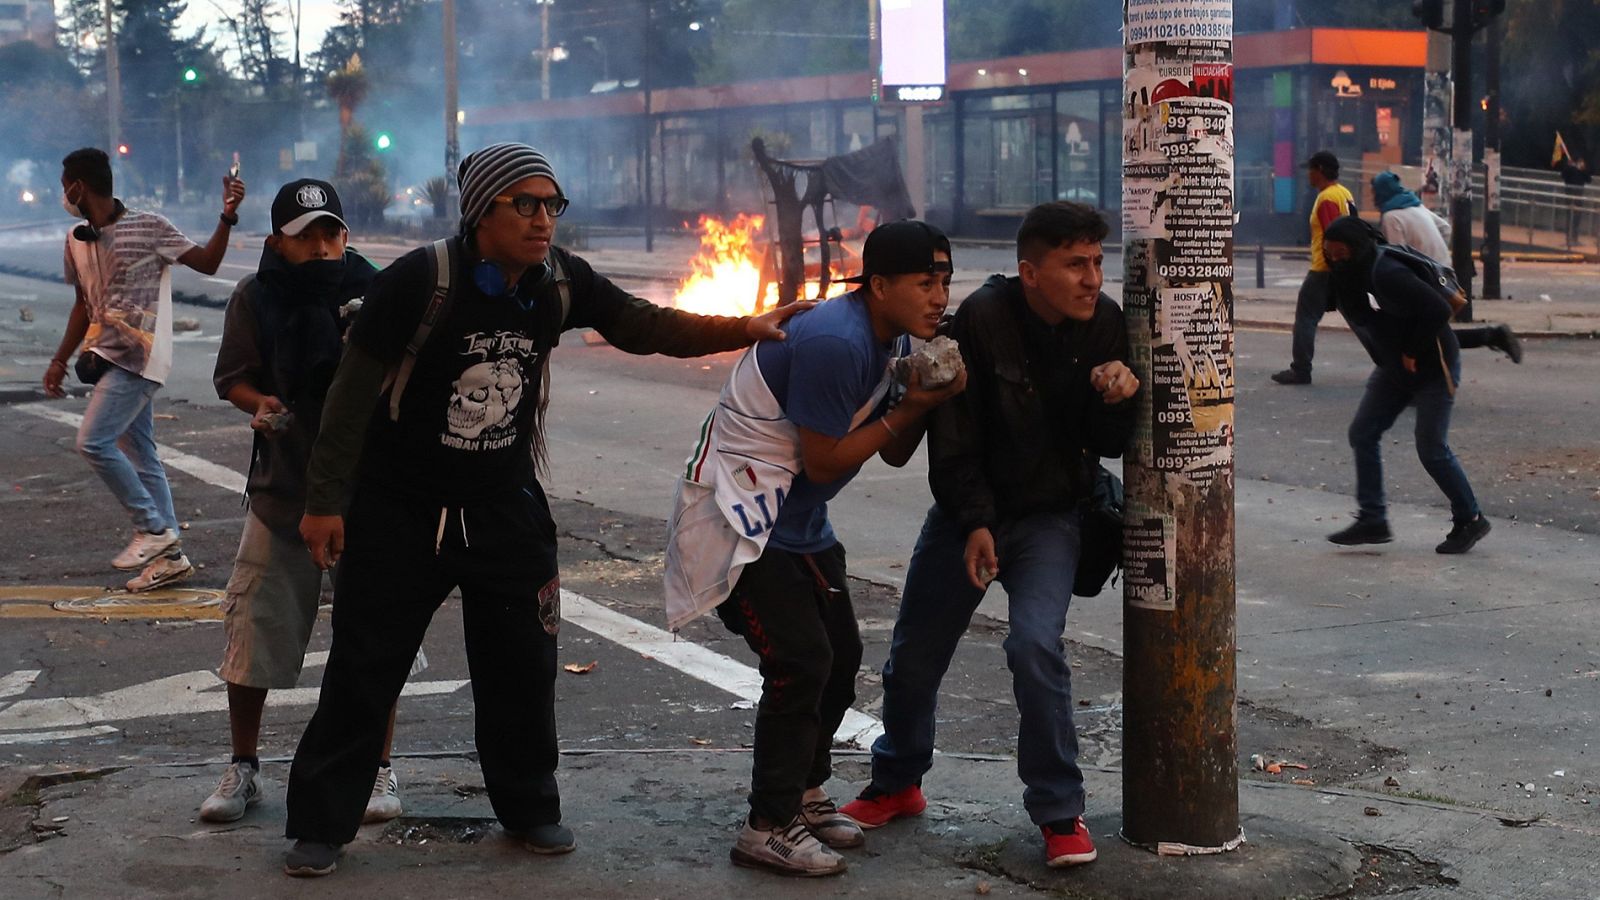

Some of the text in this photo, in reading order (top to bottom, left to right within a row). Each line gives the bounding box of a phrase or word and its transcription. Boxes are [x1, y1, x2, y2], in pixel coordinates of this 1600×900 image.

[1145, 9, 1158, 20] todo
[1160, 8, 1172, 21] tipo
[1174, 7, 1182, 18] de
[1184, 8, 1209, 20] trabajos
[1177, 47, 1187, 55] del
[1160, 67, 1181, 77] CURSO
[1184, 67, 1192, 77] DE
[1170, 107, 1193, 115] Limpias
[1152, 166, 1166, 174] DEL
[303, 190, 322, 201] NY
[1187, 229, 1193, 237] el
[1181, 248, 1203, 256] Lectura
[1204, 248, 1210, 256] de
[1170, 256, 1194, 264] Limpias
[1160, 265, 1232, 278] 0993284097
[1196, 322, 1213, 334] Brujo
[1154, 372, 1171, 384] Único
[1158, 411, 1193, 423] 0993
[441, 433, 479, 451] URBAN
[1177, 438, 1199, 446] Lectura
[1200, 438, 1206, 446] de
[1167, 447, 1190, 456] Limpias
[765, 836, 792, 859] PUMA
